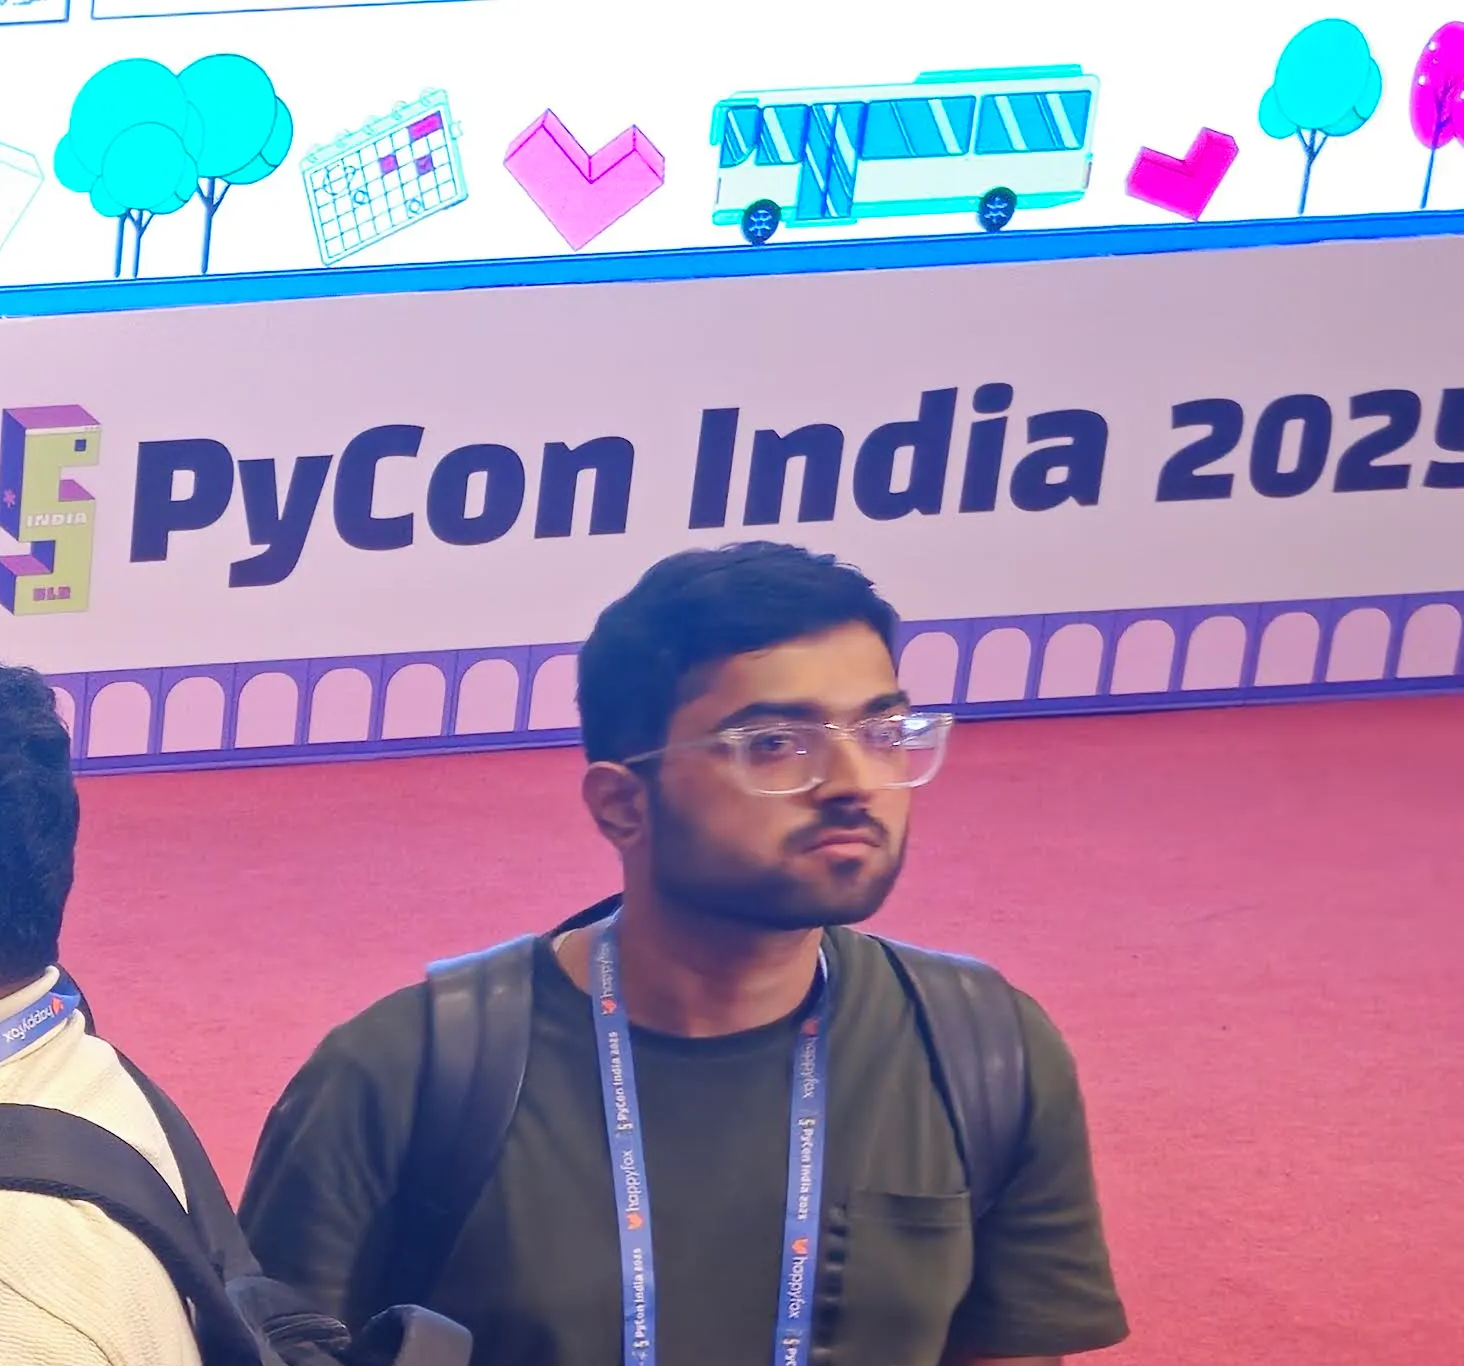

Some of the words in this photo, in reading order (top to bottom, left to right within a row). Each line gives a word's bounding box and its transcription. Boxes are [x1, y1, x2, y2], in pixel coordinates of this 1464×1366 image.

[130, 423, 635, 588] PyCon
[688, 381, 1110, 531] India
[26, 512, 87, 527] INDIA
[3, 1006, 54, 1043] happyfox
[612, 1057, 623, 1088] India
[616, 1089, 627, 1123] PyCon
[801, 1129, 814, 1163] PyCon
[620, 1150, 641, 1212] happyfox
[800, 1164, 811, 1194] India
[632, 1272, 643, 1302] India
[788, 1257, 808, 1319] happyfox
[634, 1303, 645, 1338] PyCon
